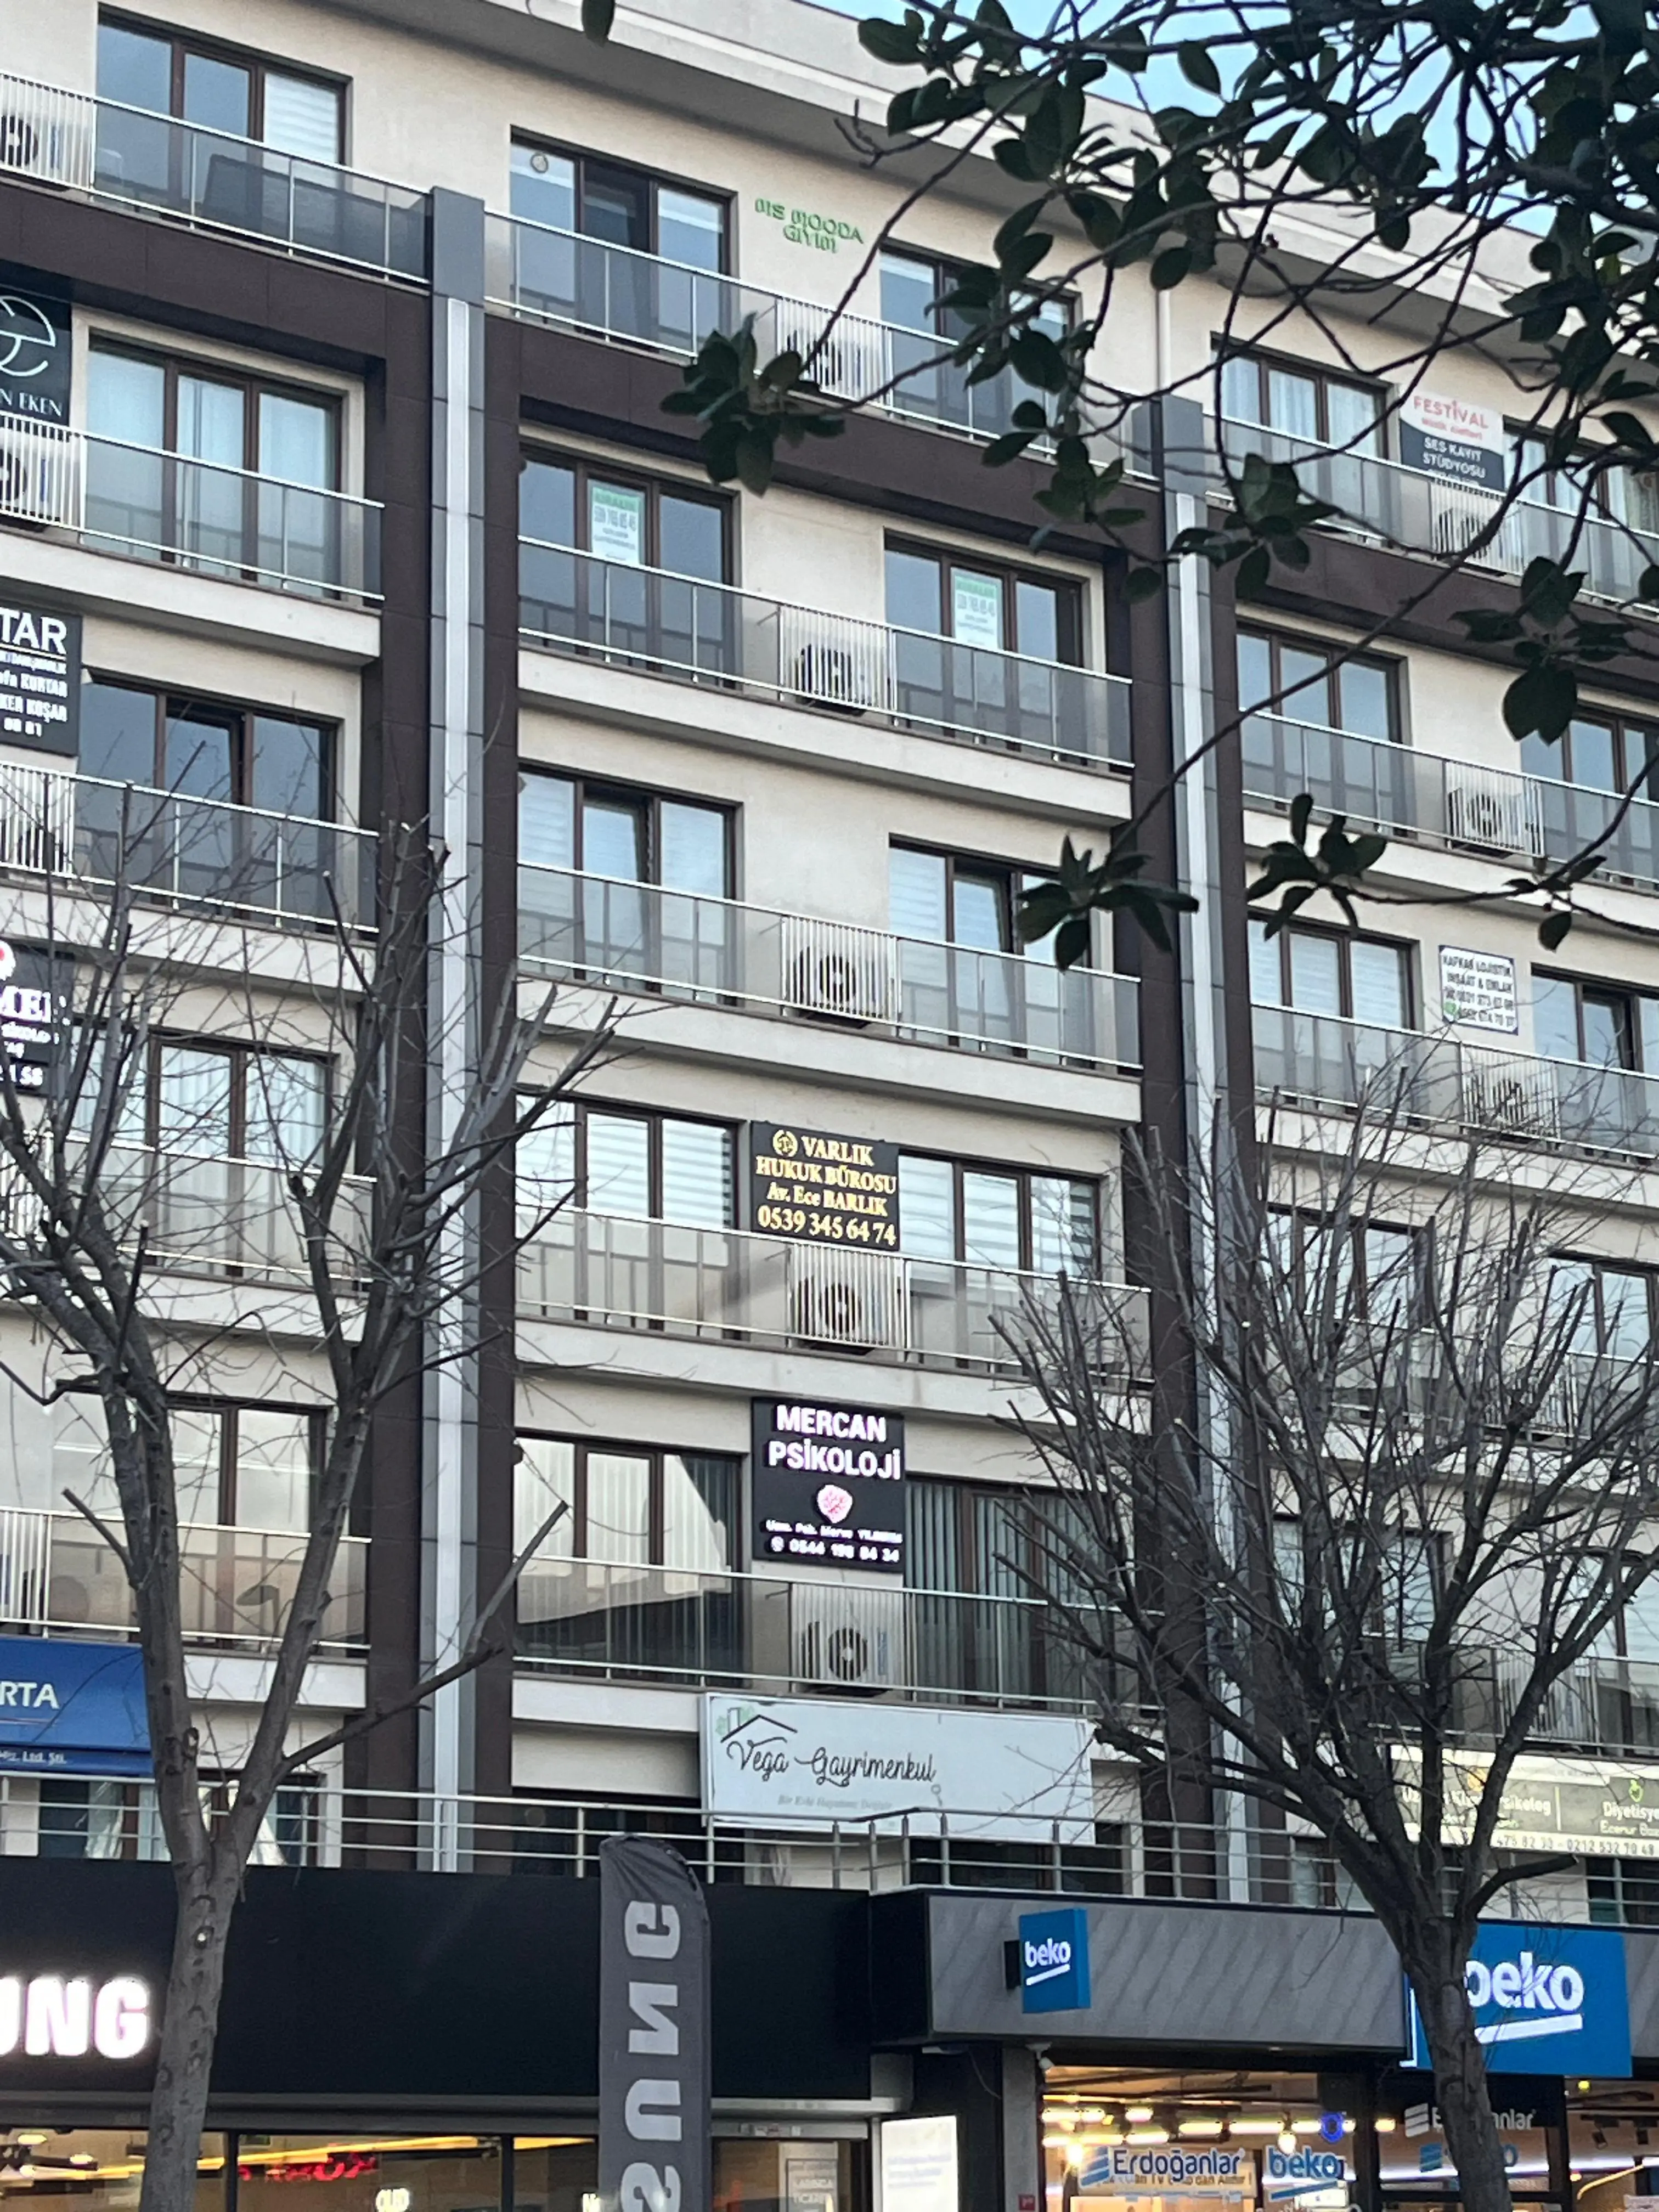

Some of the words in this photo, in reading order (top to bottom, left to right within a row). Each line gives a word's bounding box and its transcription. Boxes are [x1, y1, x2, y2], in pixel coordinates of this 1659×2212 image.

[801, 1136, 874, 1167] VARLIK
[755, 1155, 823, 1184] HUKUK
[825, 1165, 897, 1194] BÜROSU
[767, 1181, 791, 1203] Av.
[793, 1184, 821, 1207] Ece
[758, 1205, 806, 1233] 0539
[808, 1212, 844, 1239] 345
[845, 1217, 871, 1243] 64
[872, 1222, 897, 1246] 74
[776, 1404, 887, 1442] MERCAN
[768, 1437, 901, 1480] PSİKOLOJİ
[726, 1736, 789, 1782] Vega
[794, 1746, 937, 1788] Gayrimenkul
[1024, 1937, 1071, 1967] beko
[1113, 2148, 1241, 2182] Erdoğanlar
[1268, 2147, 1338, 2179] beko
